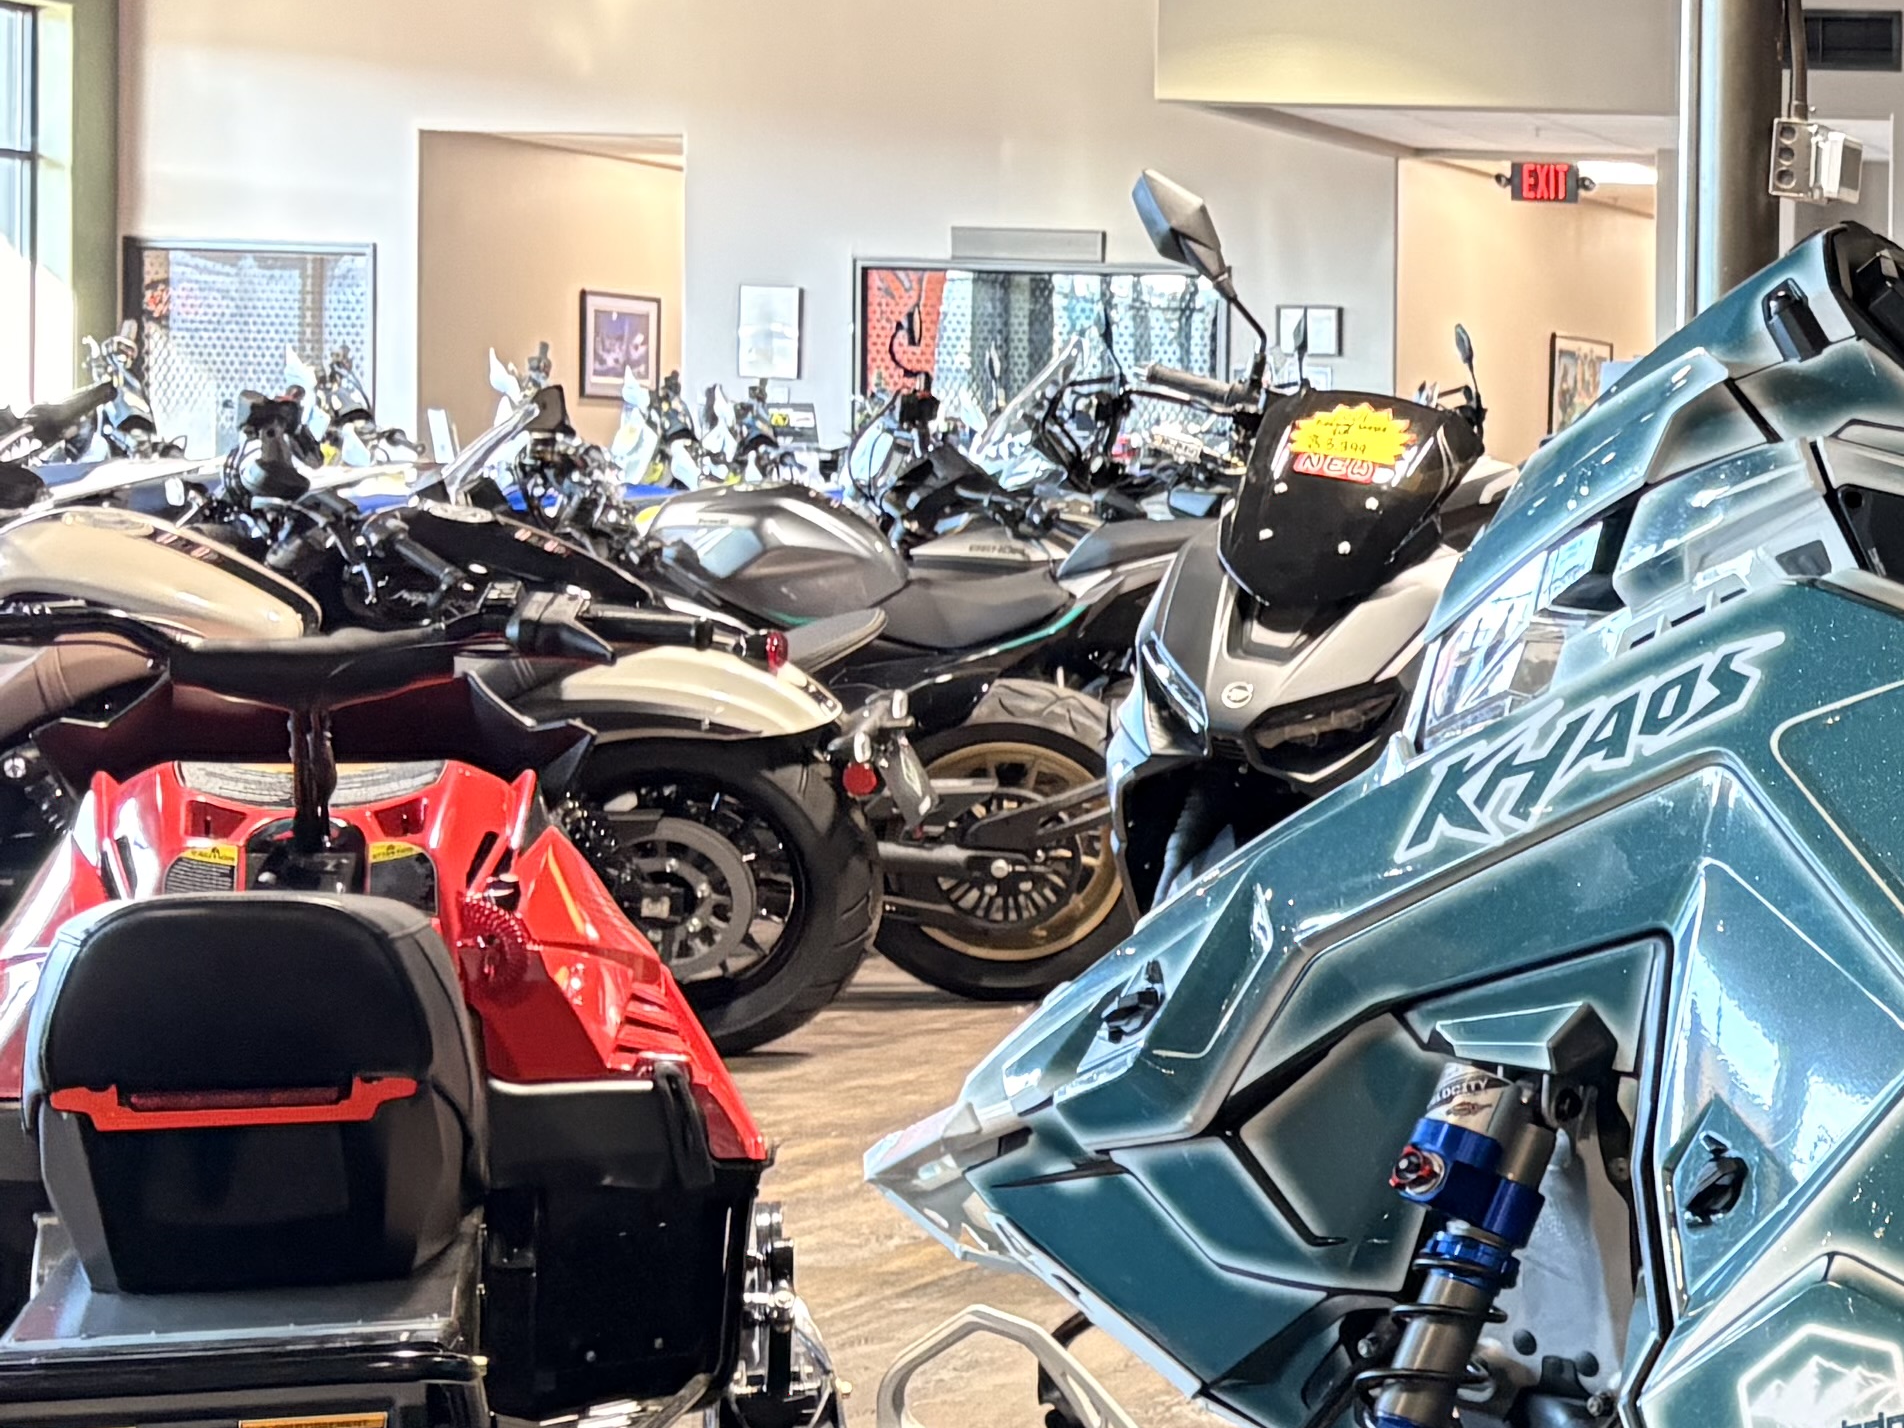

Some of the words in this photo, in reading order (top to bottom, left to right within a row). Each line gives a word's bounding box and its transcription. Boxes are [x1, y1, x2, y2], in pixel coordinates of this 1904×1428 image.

[1522, 163, 1569, 200] EXIT
[1300, 454, 1371, 478] NEW
[1395, 631, 1785, 862] KHAOS
